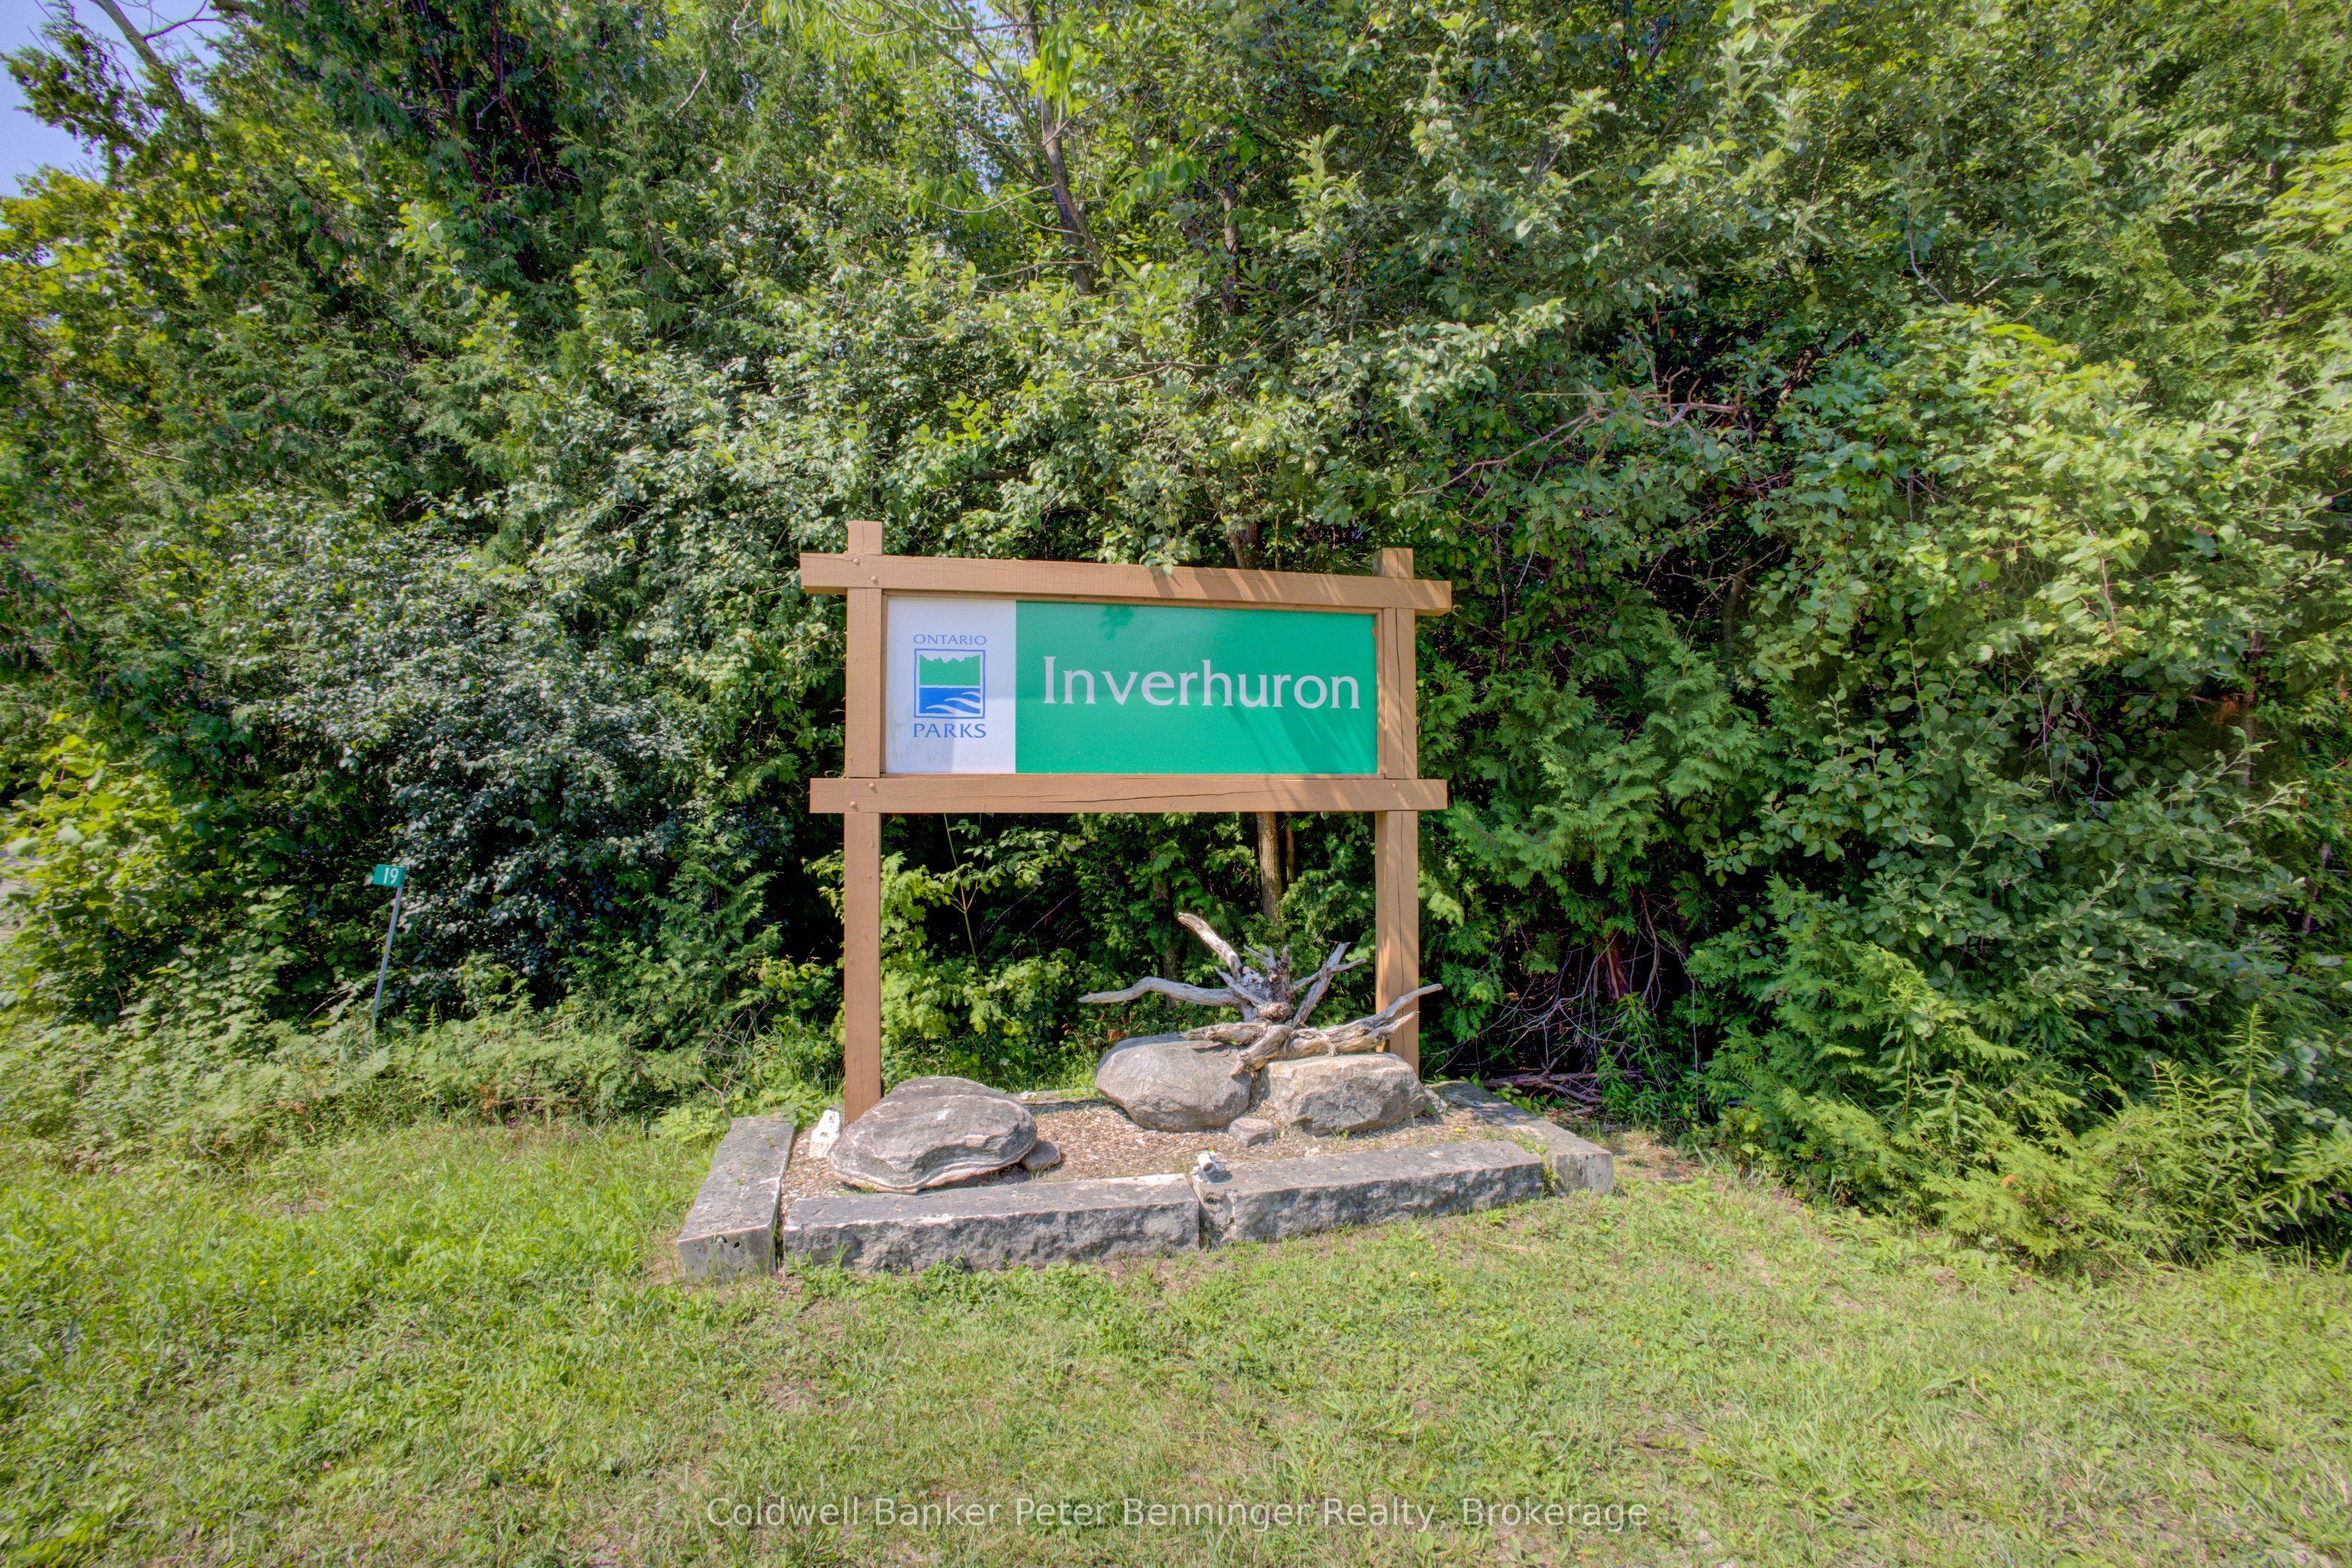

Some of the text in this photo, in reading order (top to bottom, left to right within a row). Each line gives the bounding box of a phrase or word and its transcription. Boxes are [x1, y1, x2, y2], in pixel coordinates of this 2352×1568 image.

[913, 634, 987, 645] ONTARIO
[1042, 656, 1360, 709] Inverhuron
[913, 723, 987, 738] PARKS
[383, 868, 399, 884] 19
